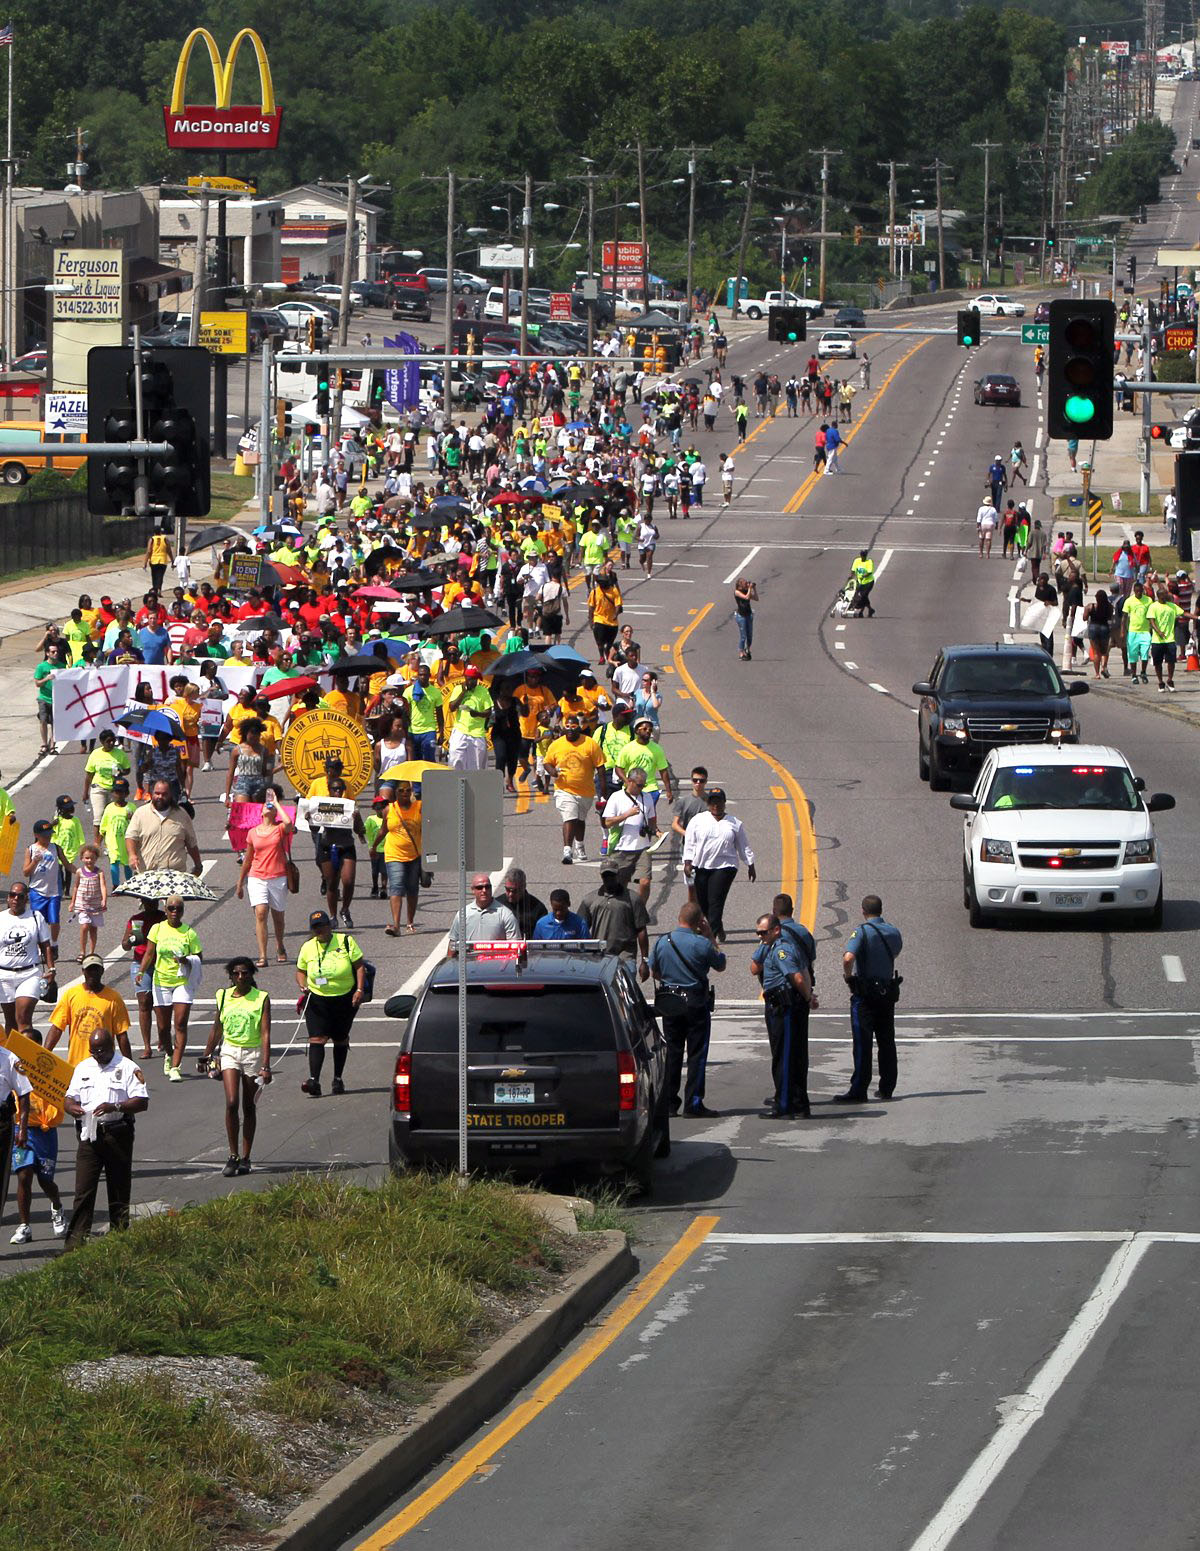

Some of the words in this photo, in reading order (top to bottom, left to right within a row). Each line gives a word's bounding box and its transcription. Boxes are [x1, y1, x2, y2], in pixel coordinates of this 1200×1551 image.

[174, 120, 270, 132] McDonald's
[57, 252, 118, 277] Ferguson
[84, 279, 92, 295] &
[57, 301, 118, 314] 314/522-3011
[1168, 337, 1193, 346] CHOP
[285, 736, 296, 777] ASSOCIATION
[294, 721, 306, 732] FOR
[307, 713, 319, 722] THE
[323, 712, 362, 739] ADVANCEMENT
[359, 752, 370, 780] COLORED
[313, 749, 342, 760] NAACP
[467, 1114, 502, 1126] STATE
[506, 1114, 566, 1126] TROOPER
